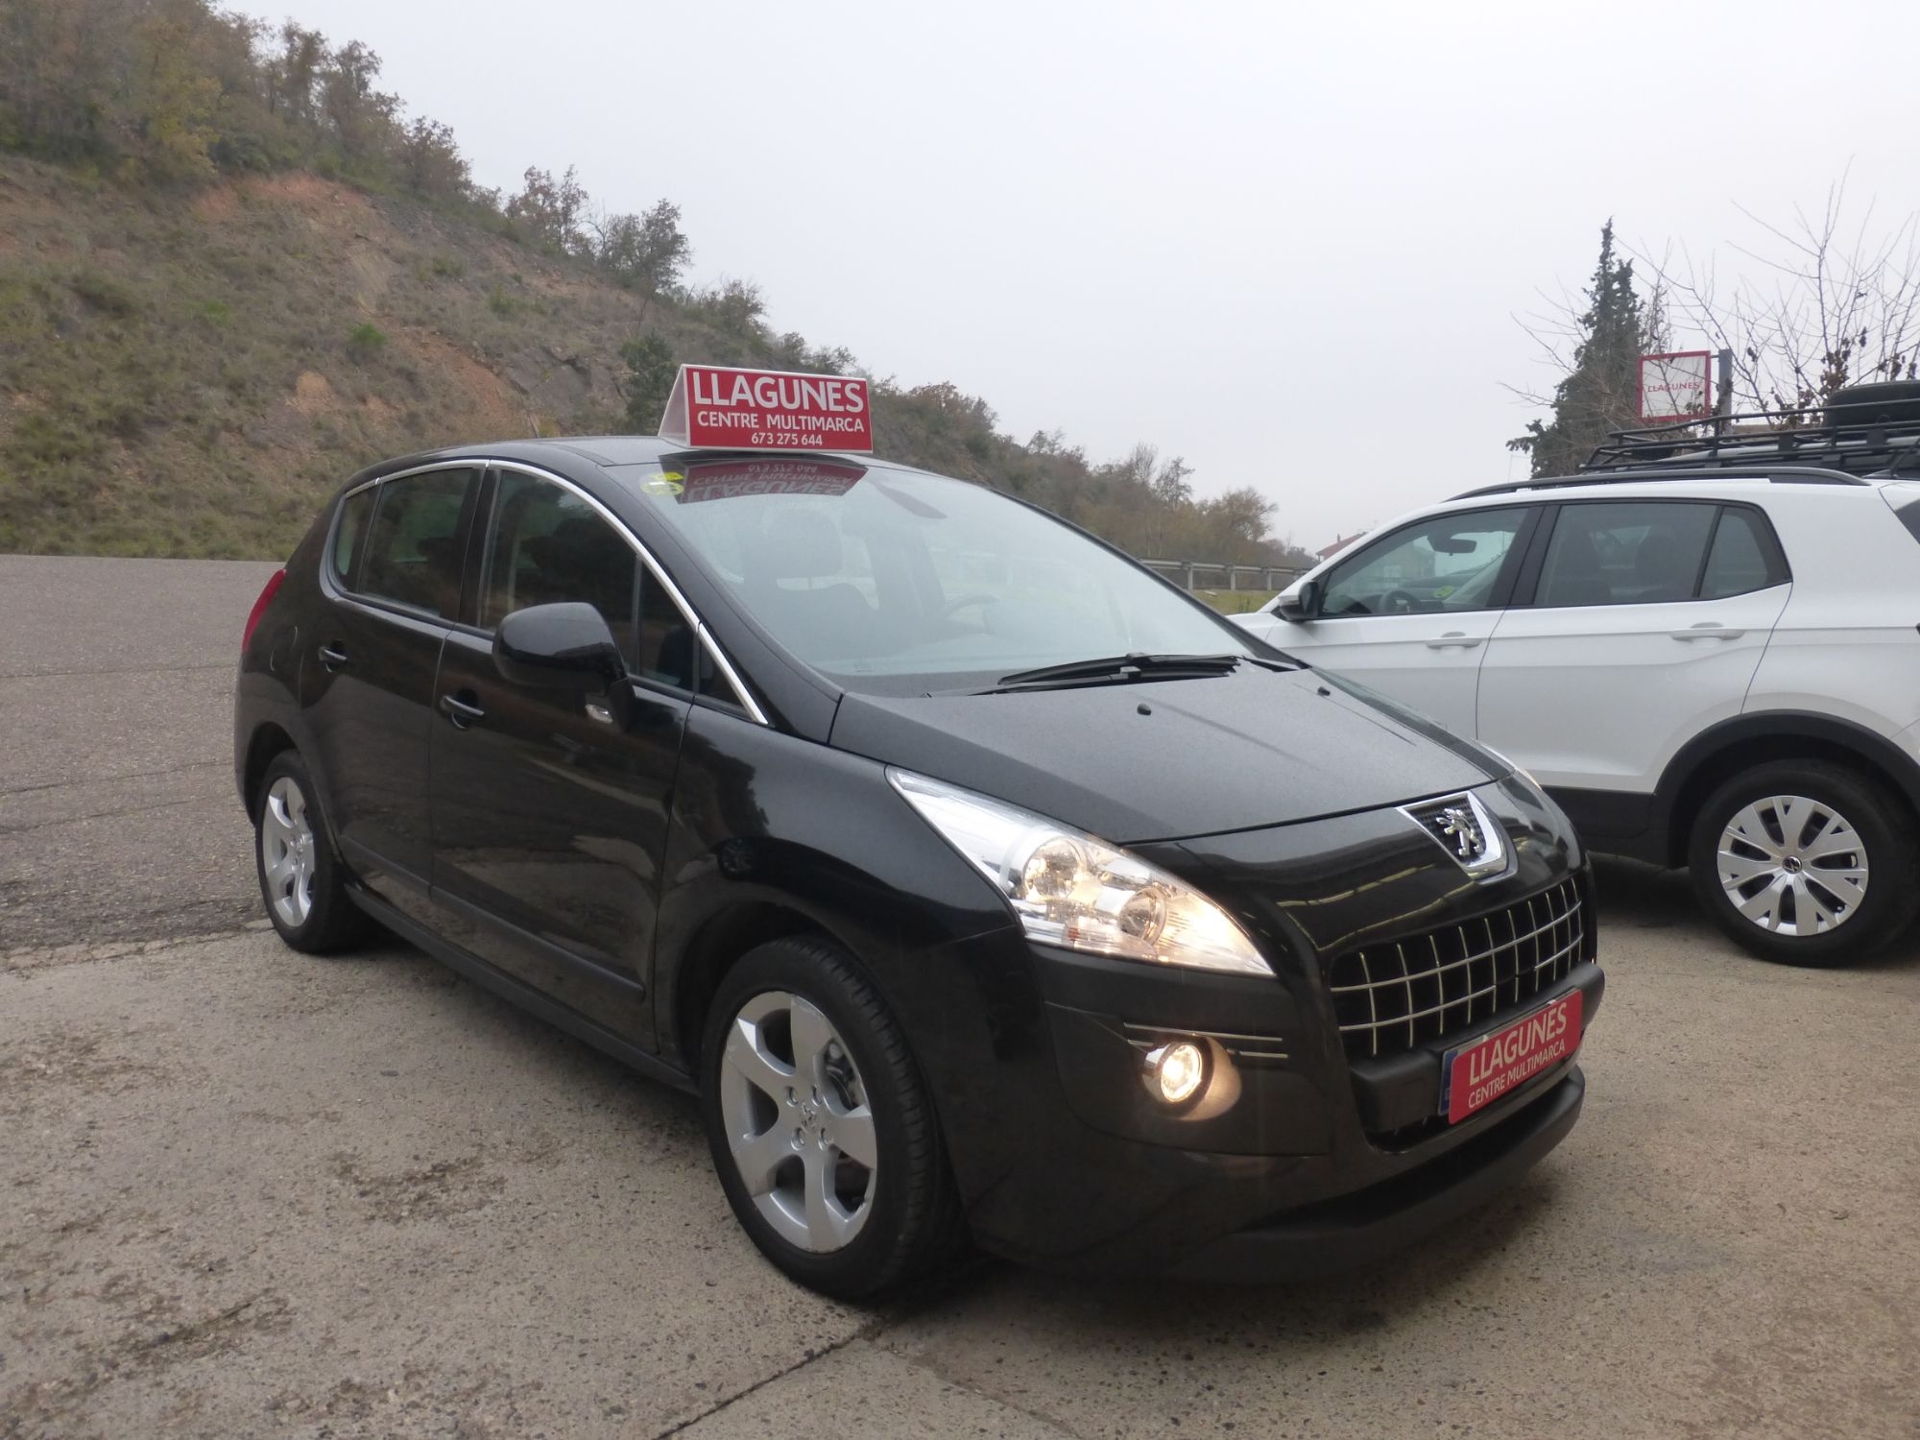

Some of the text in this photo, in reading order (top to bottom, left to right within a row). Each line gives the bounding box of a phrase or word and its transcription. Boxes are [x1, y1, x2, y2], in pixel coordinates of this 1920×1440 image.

[693, 371, 864, 413] LLAGUNES
[697, 411, 864, 432] CENTRE MULTIMARCA
[751, 432, 822, 446] 673 275 644
[1469, 1002, 1567, 1086] LLAGUNES
[1468, 1038, 1566, 1109] CENTRE MULTIMARCA
